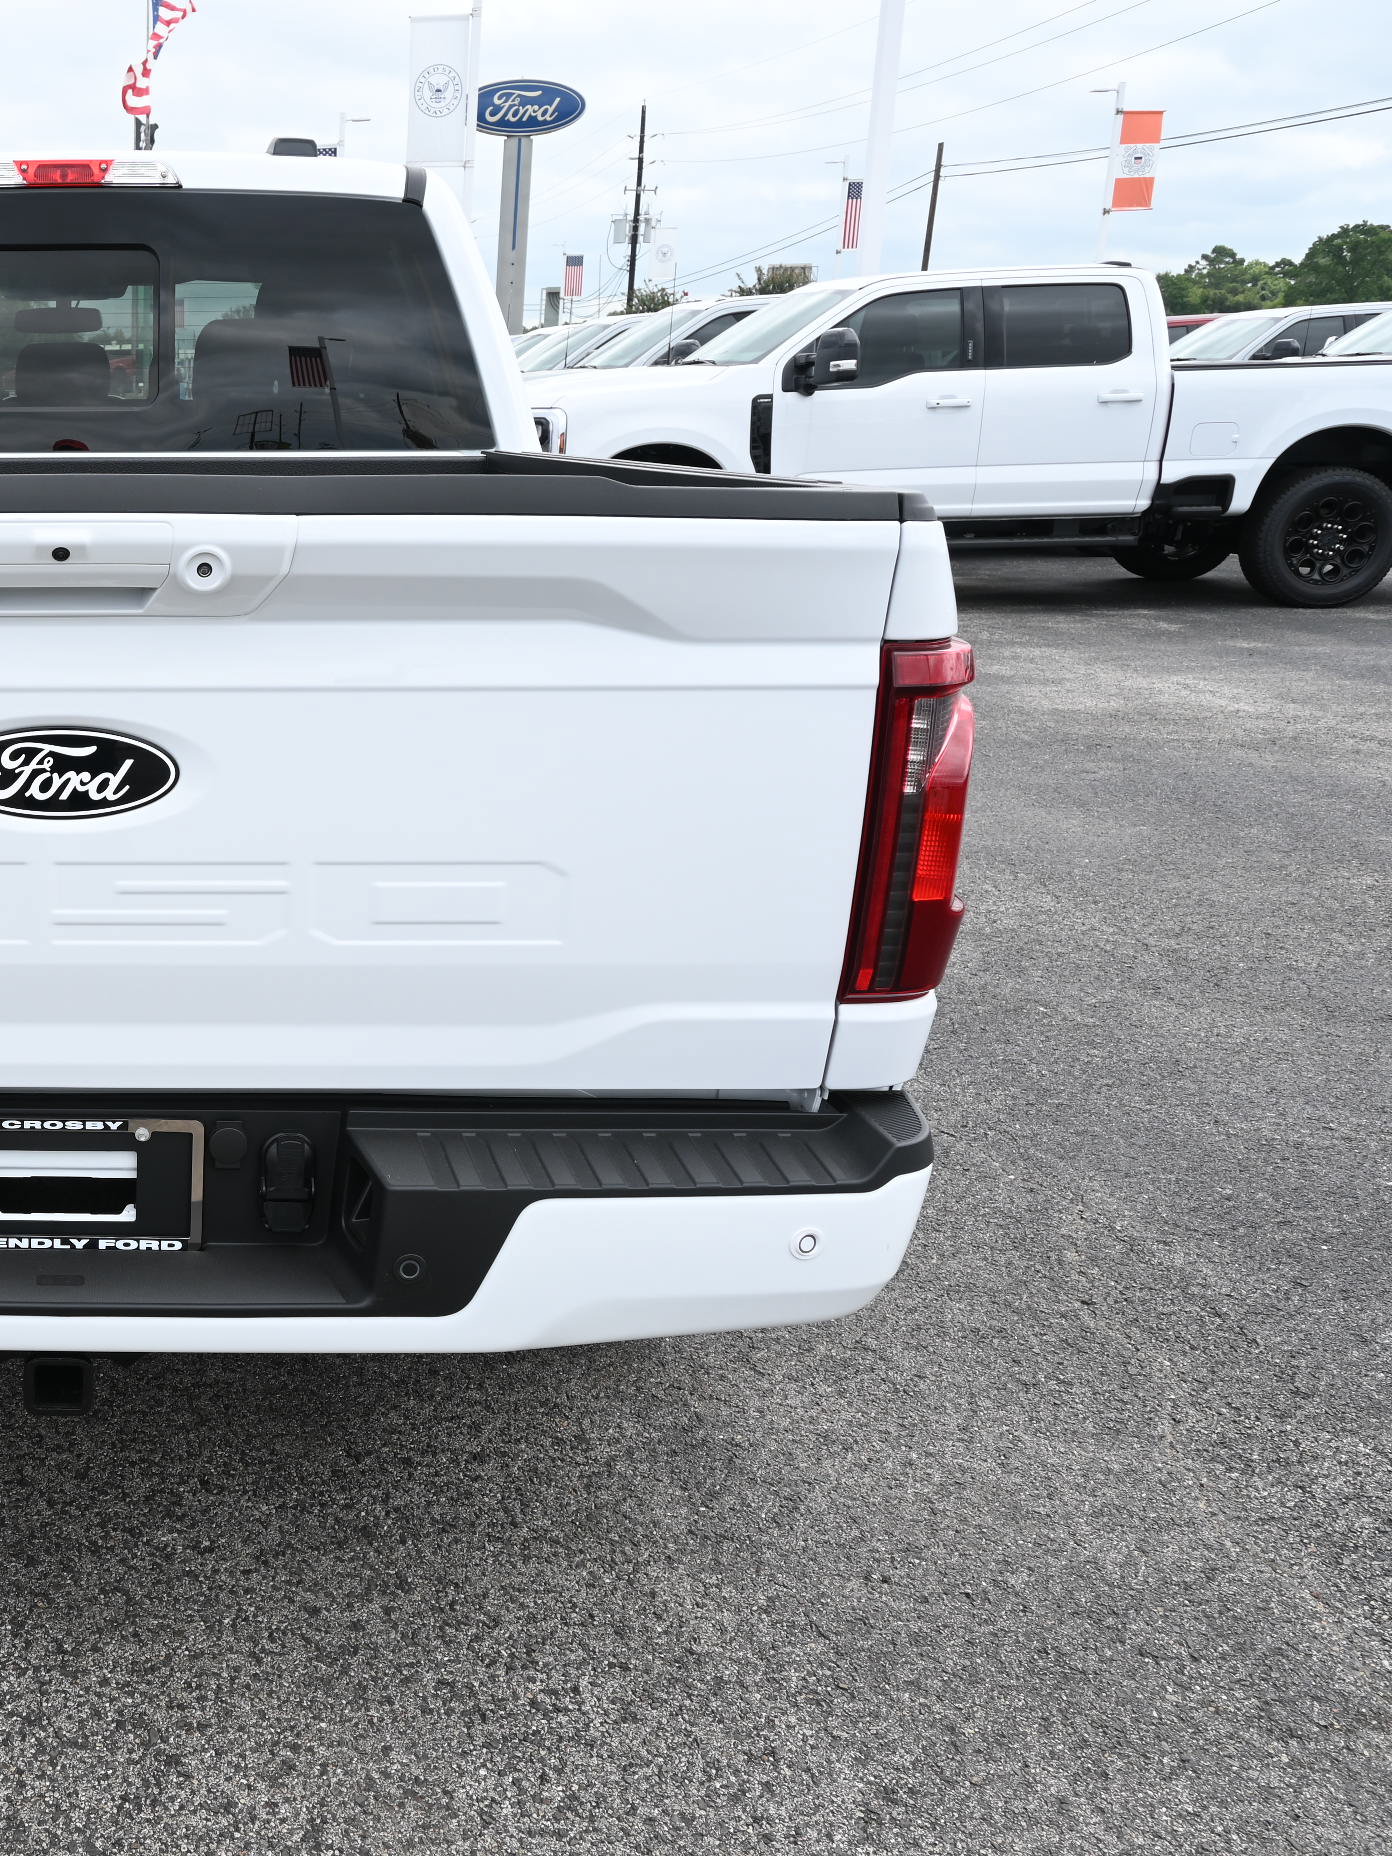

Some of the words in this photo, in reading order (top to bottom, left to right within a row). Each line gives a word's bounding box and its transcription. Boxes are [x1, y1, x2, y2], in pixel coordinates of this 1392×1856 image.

[485, 89, 560, 123] Ford
[1, 1120, 124, 1130] CROSBY
[98, 1239, 183, 1251] FORD
